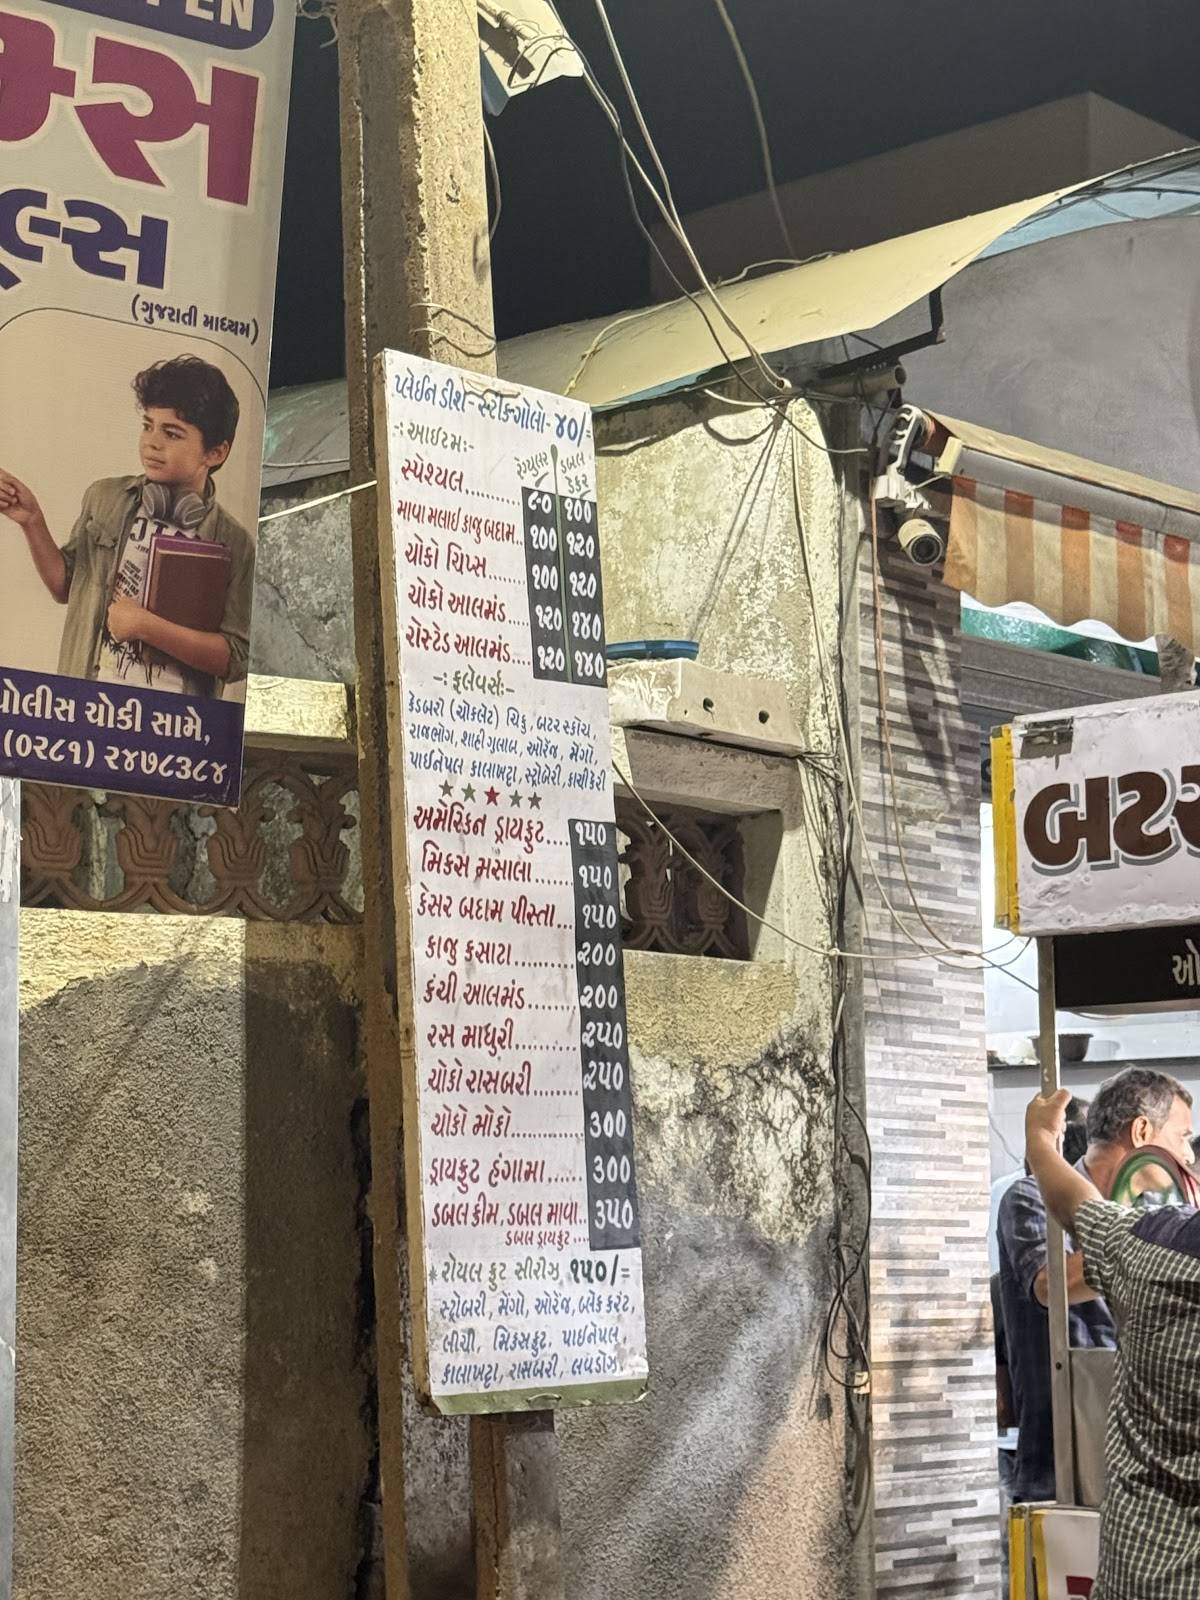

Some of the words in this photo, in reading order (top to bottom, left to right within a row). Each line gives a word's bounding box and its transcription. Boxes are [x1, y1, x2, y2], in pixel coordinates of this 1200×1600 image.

[132, 294, 198, 327] (ગુજરાતી
[564, 497, 592, 524] ૧૦૦
[397, 500, 426, 524] માવા
[462, 514, 483, 544] કાજુ
[530, 524, 557, 552] ૧૦૦
[566, 531, 595, 559] ૧૨૦
[405, 533, 440, 570] ચોકો
[532, 564, 559, 591] ૧૦૦
[569, 571, 597, 599] ૧૨૦
[408, 576, 443, 611] ચોકો
[535, 604, 562, 631] ૧૨૦
[572, 611, 602, 642] ૧૪૦
[406, 616, 450, 654] રોસ્ટેડ
[537, 645, 565, 671] ૧૨૦
[574, 649, 605, 679] ૧૪૦
[84, 692, 142, 733] ચોકી
[151, 706, 211, 746] સામે,
[537, 715, 560, 734] બટર
[461, 727, 486, 751] શાહી
[4, 729, 95, 769] (૦૨૮૧)
[104, 745, 228, 785] ૨૪૭૮૩૮૪
[413, 798, 487, 837] અમેરિકન
[575, 821, 607, 846] ૧૫૦
[579, 865, 613, 890] ૧૫૦
[417, 882, 453, 918] કેસર
[459, 895, 504, 924] બદામ
[582, 904, 617, 930] ૧૫૦
[425, 934, 458, 967] કાજુ
[577, 941, 616, 967] ૨૦૦
[580, 983, 618, 1009] ૨૦૦
[427, 1023, 455, 1048] રસ
[582, 1021, 623, 1050] ૨૫૦
[428, 1057, 463, 1095] ચોકો
[583, 1060, 624, 1092] ૨૫૦
[430, 1103, 468, 1137] ચોકો
[589, 1108, 627, 1139] ૩૦૦
[592, 1154, 631, 1185] ૩૦૦
[431, 1201, 469, 1227] ડબલ
[507, 1201, 543, 1227] ડબલ
[594, 1198, 634, 1230] ૩૫૦
[505, 1229, 534, 1247] ડબલ
